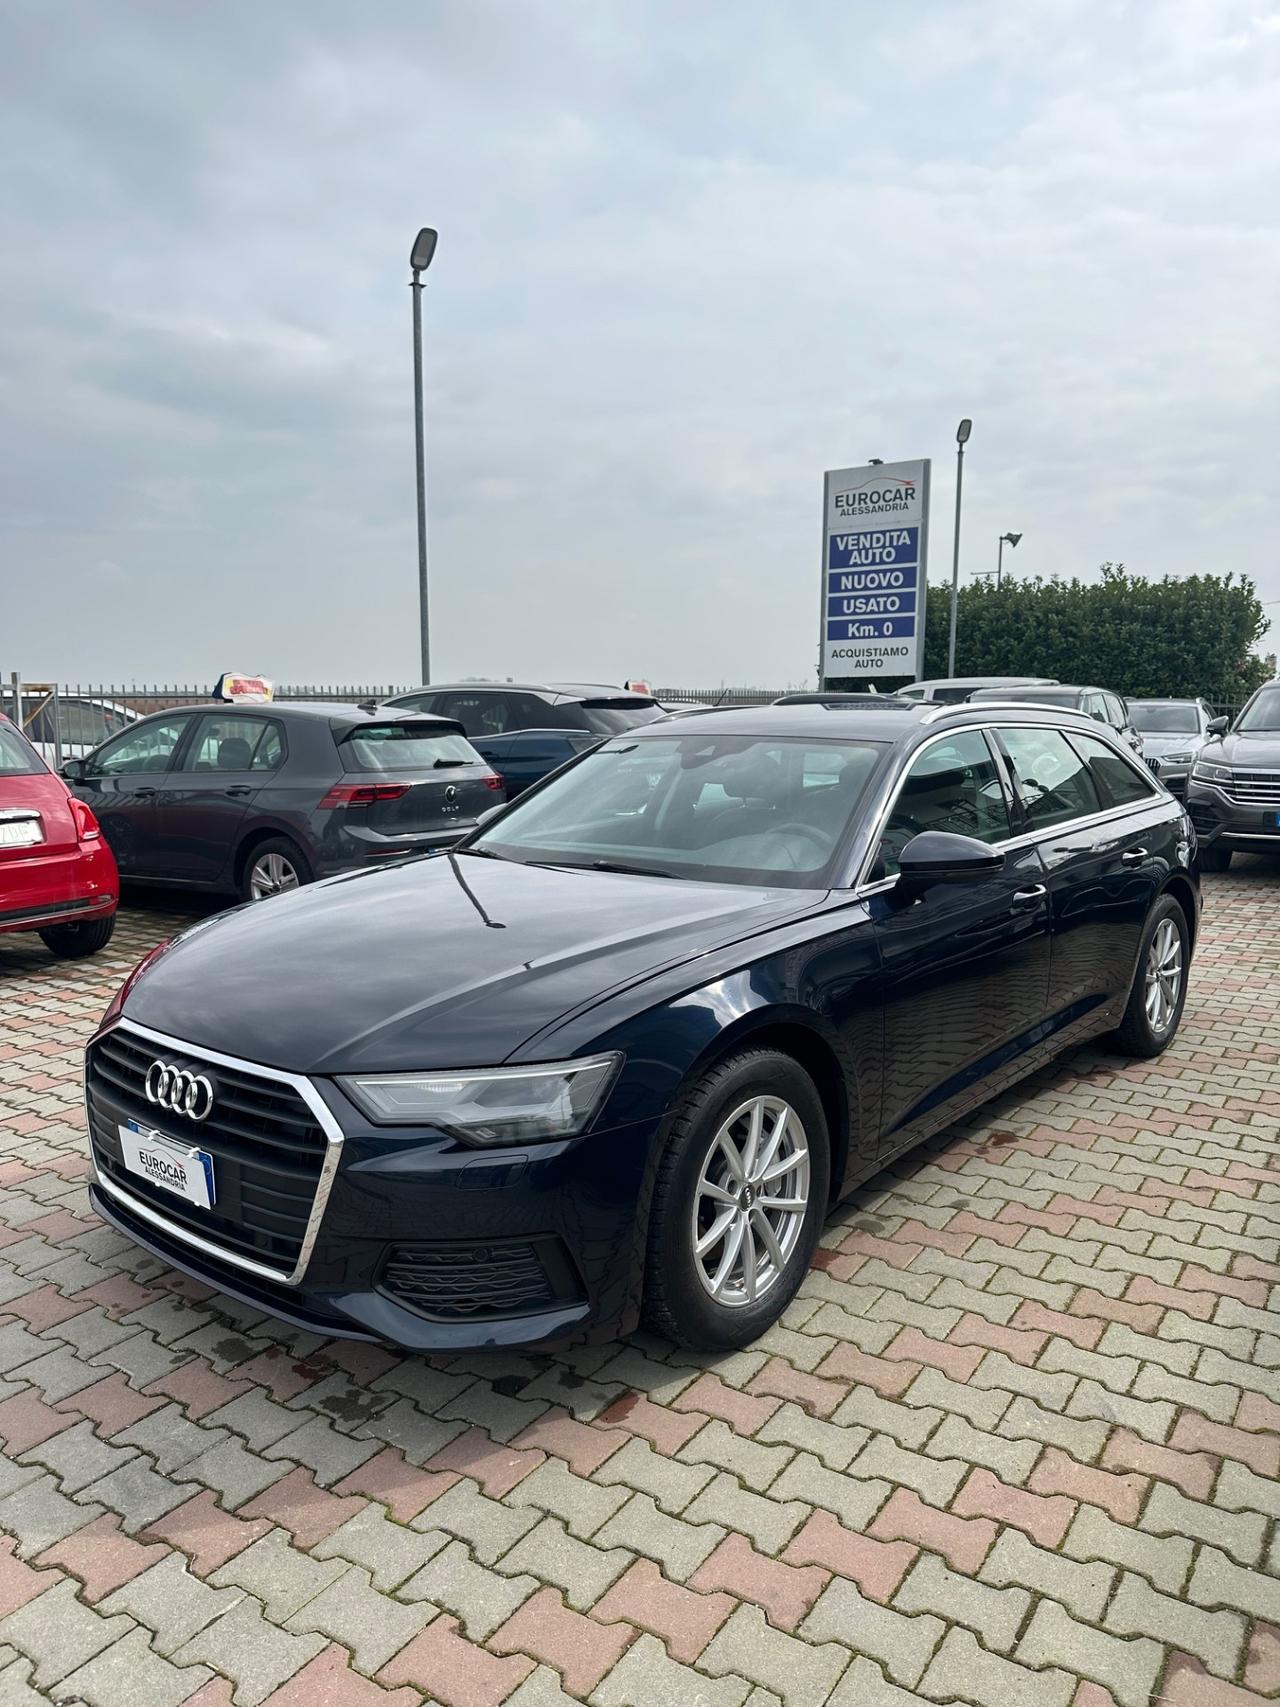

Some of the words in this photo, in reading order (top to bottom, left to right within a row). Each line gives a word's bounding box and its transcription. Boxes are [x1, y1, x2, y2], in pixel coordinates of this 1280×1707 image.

[835, 487, 916, 508] EUROCAR
[840, 502, 909, 517] ALESSANDRIA
[836, 531, 911, 551] VENDITA
[849, 547, 896, 565] AUTO
[841, 571, 904, 590] NUOVO
[843, 596, 900, 614] USATO
[848, 622, 878, 637] Km.
[883, 621, 893, 636] 0
[831, 646, 909, 659] ACQUISTIAMO
[854, 658, 884, 669] AUTO
[138, 1151, 188, 1185] EUROCAR
[144, 1166, 186, 1191] ALESSANDRIA
